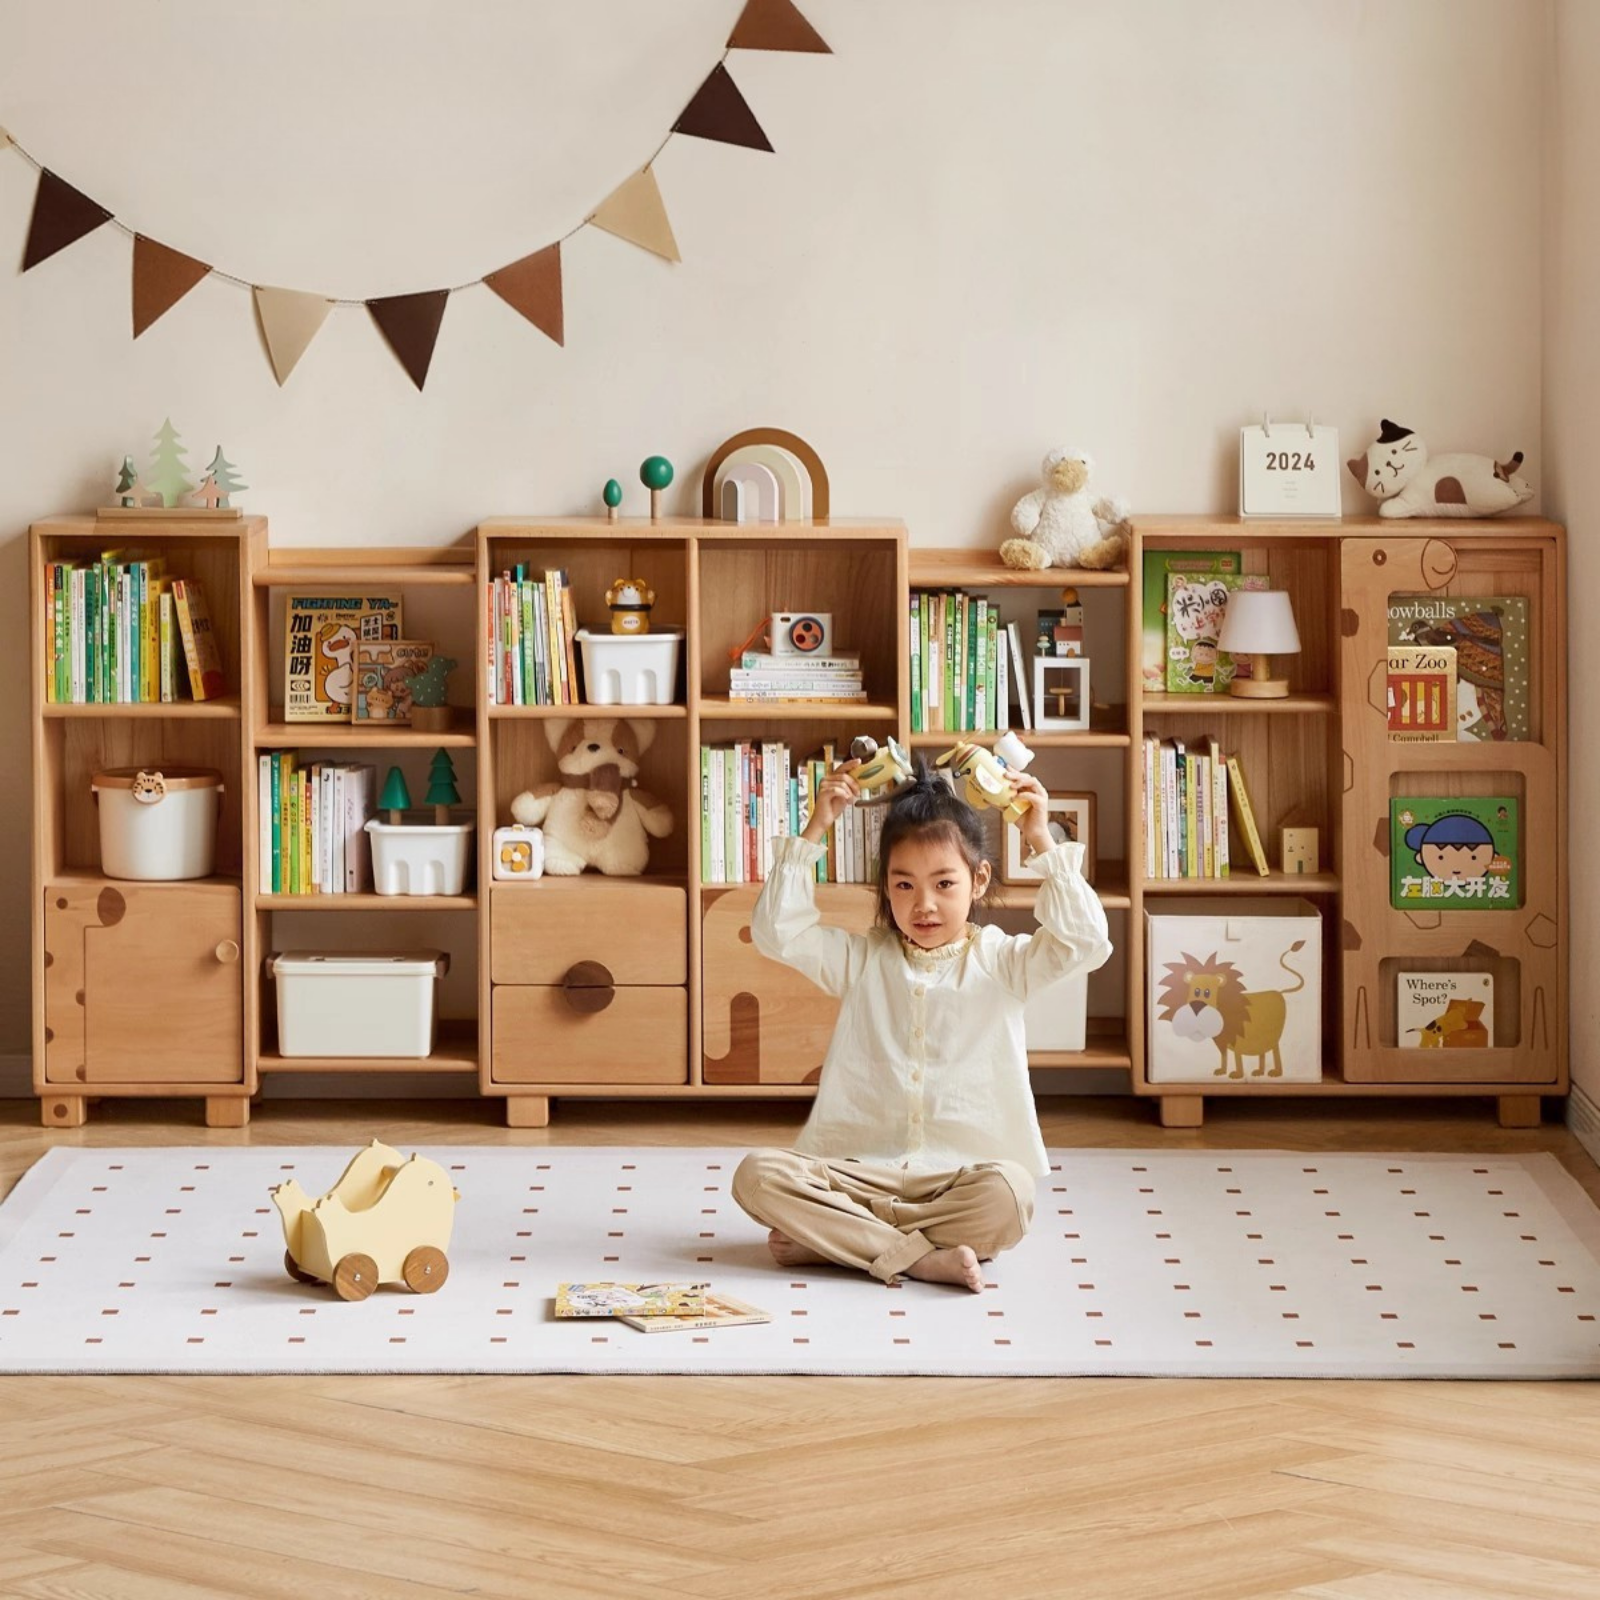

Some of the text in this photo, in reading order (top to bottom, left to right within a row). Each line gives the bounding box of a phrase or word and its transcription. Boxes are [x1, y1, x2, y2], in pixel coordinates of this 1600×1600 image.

[1266, 452, 1315, 471] 2024
[292, 598, 363, 609] FIGHTING
[289, 613, 313, 676] 加油呀
[1415, 655, 1448, 669] Zoo
[1400, 876, 1510, 898] 左脑大开发
[1407, 979, 1457, 990] Where's
[1413, 993, 1448, 1006] Spot?
